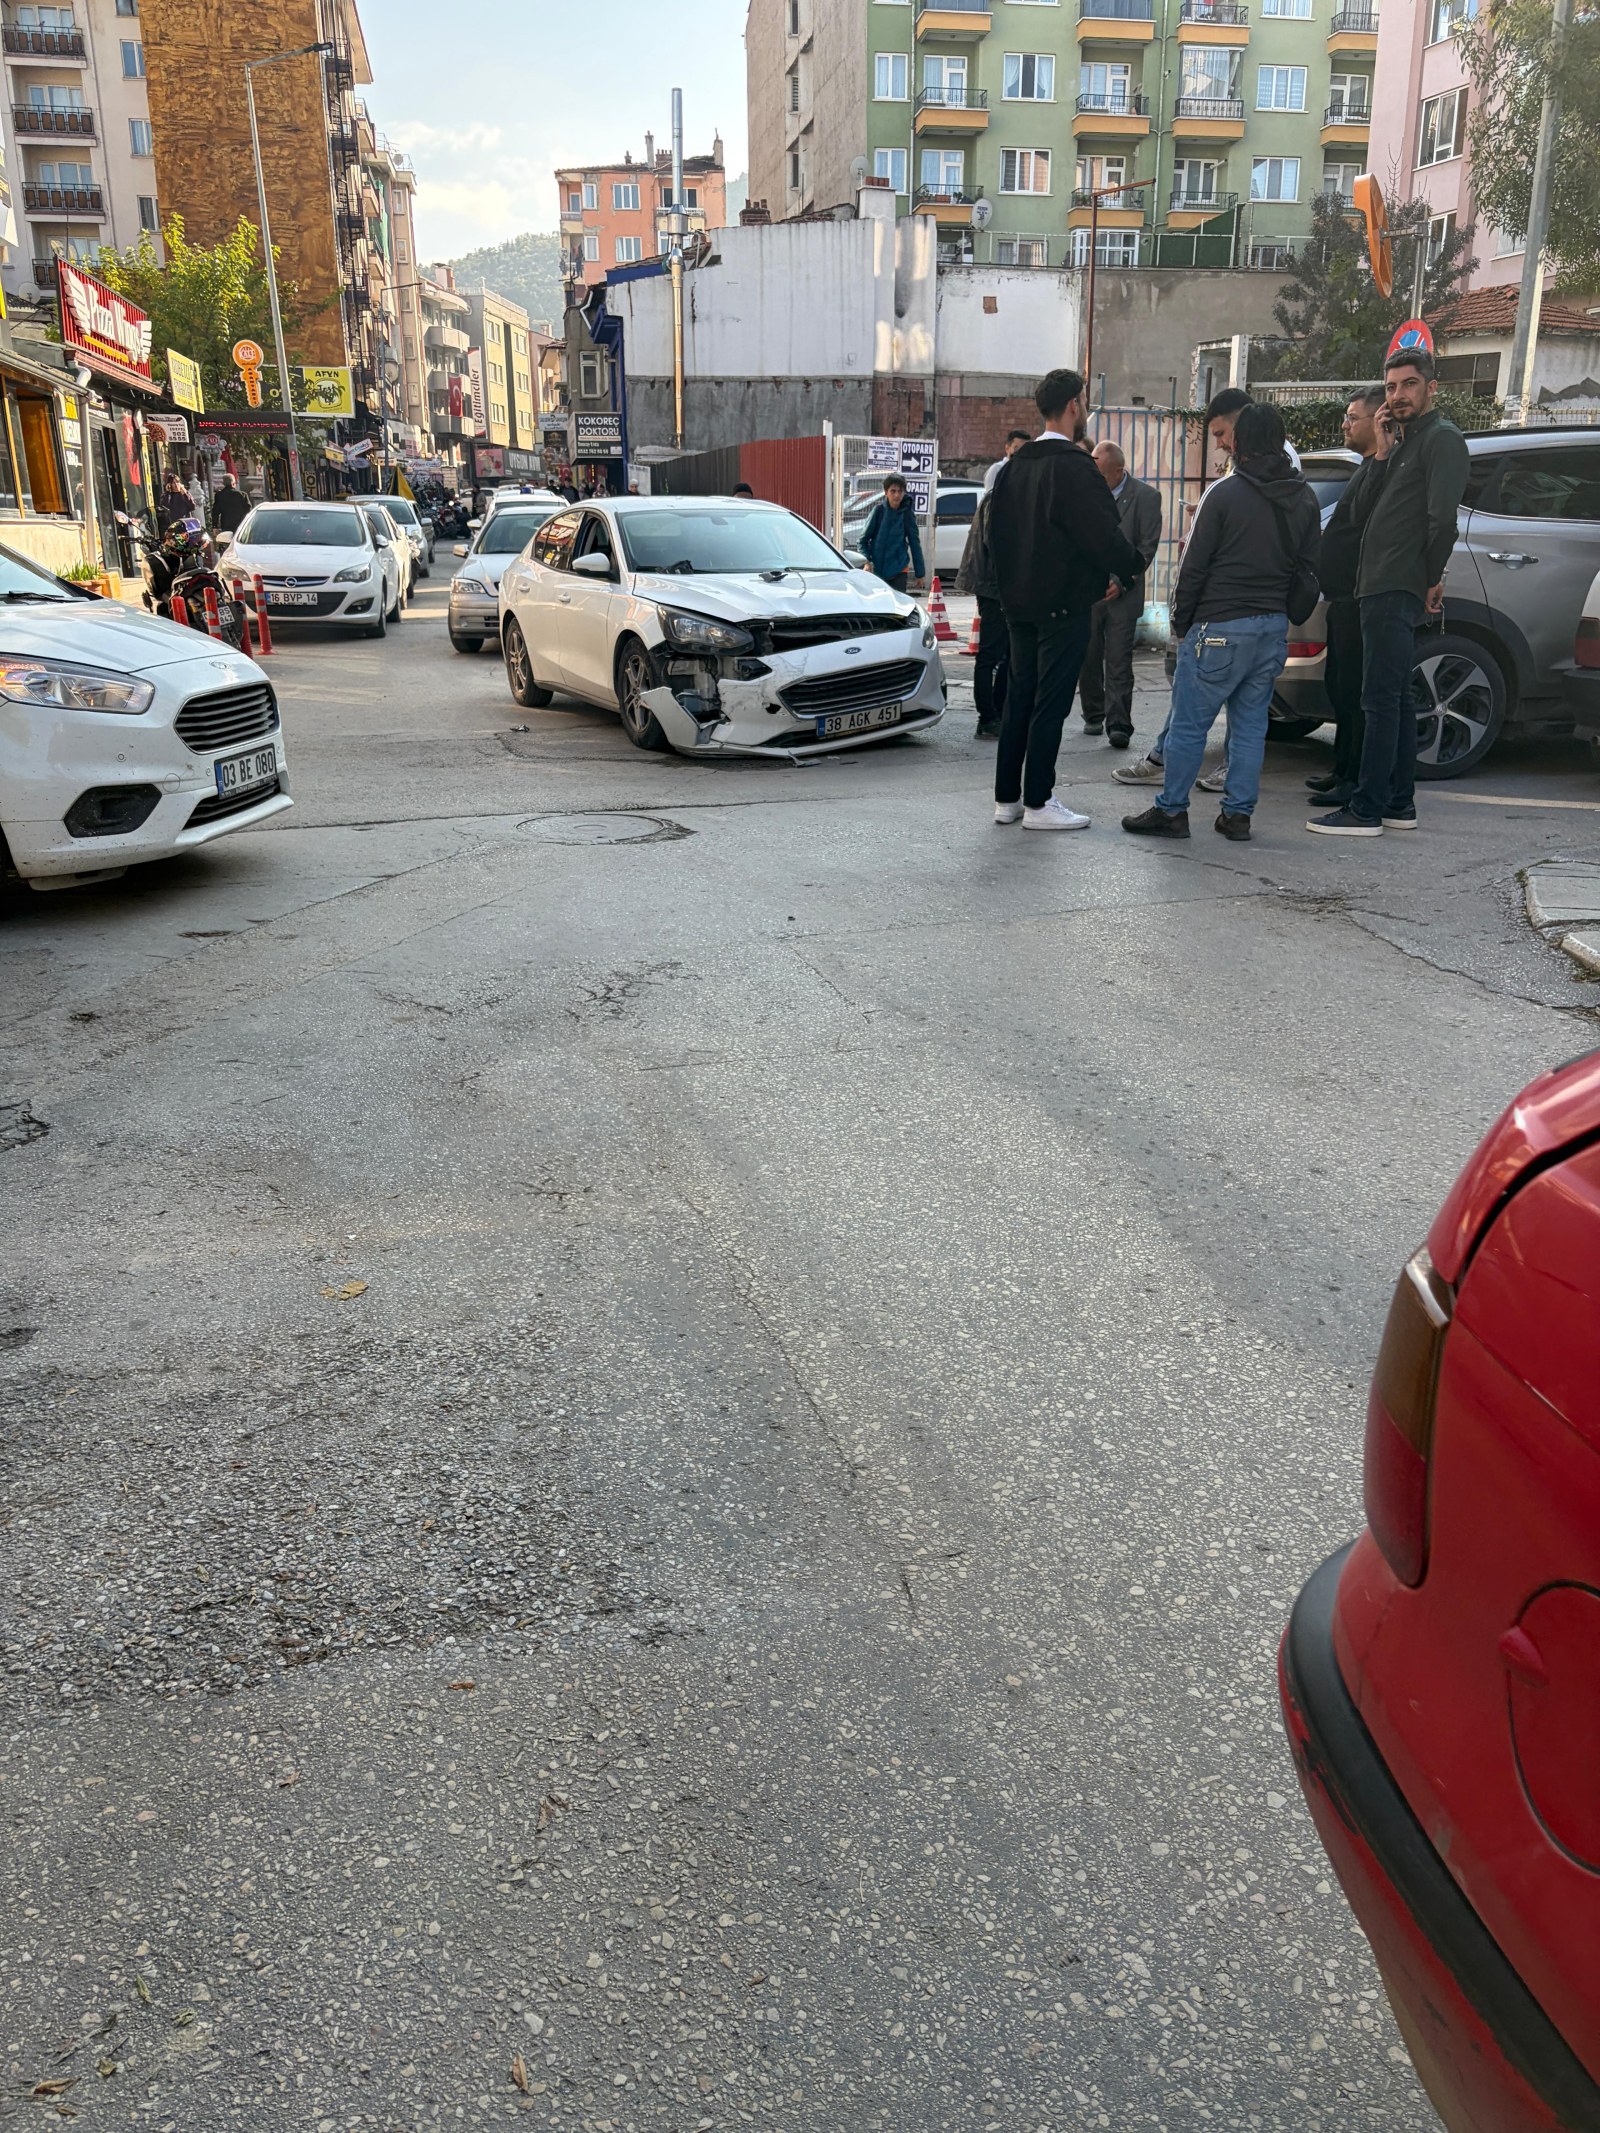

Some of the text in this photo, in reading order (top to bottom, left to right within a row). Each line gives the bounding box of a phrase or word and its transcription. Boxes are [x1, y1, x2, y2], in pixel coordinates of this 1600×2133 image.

[578, 416, 620, 427] KOKOREÇ
[579, 427, 620, 436] DOKTORU
[902, 442, 934, 454] OTOPARK
[922, 458, 930, 471] P
[906, 482, 929, 493] OPARK
[917, 496, 925, 510] P
[271, 593, 316, 602] 16 BVP 14
[827, 705, 898, 732] 38 AGK 451
[222, 763, 236, 788] 03
[239, 758, 253, 783] BE
[255, 751, 274, 776] 080
